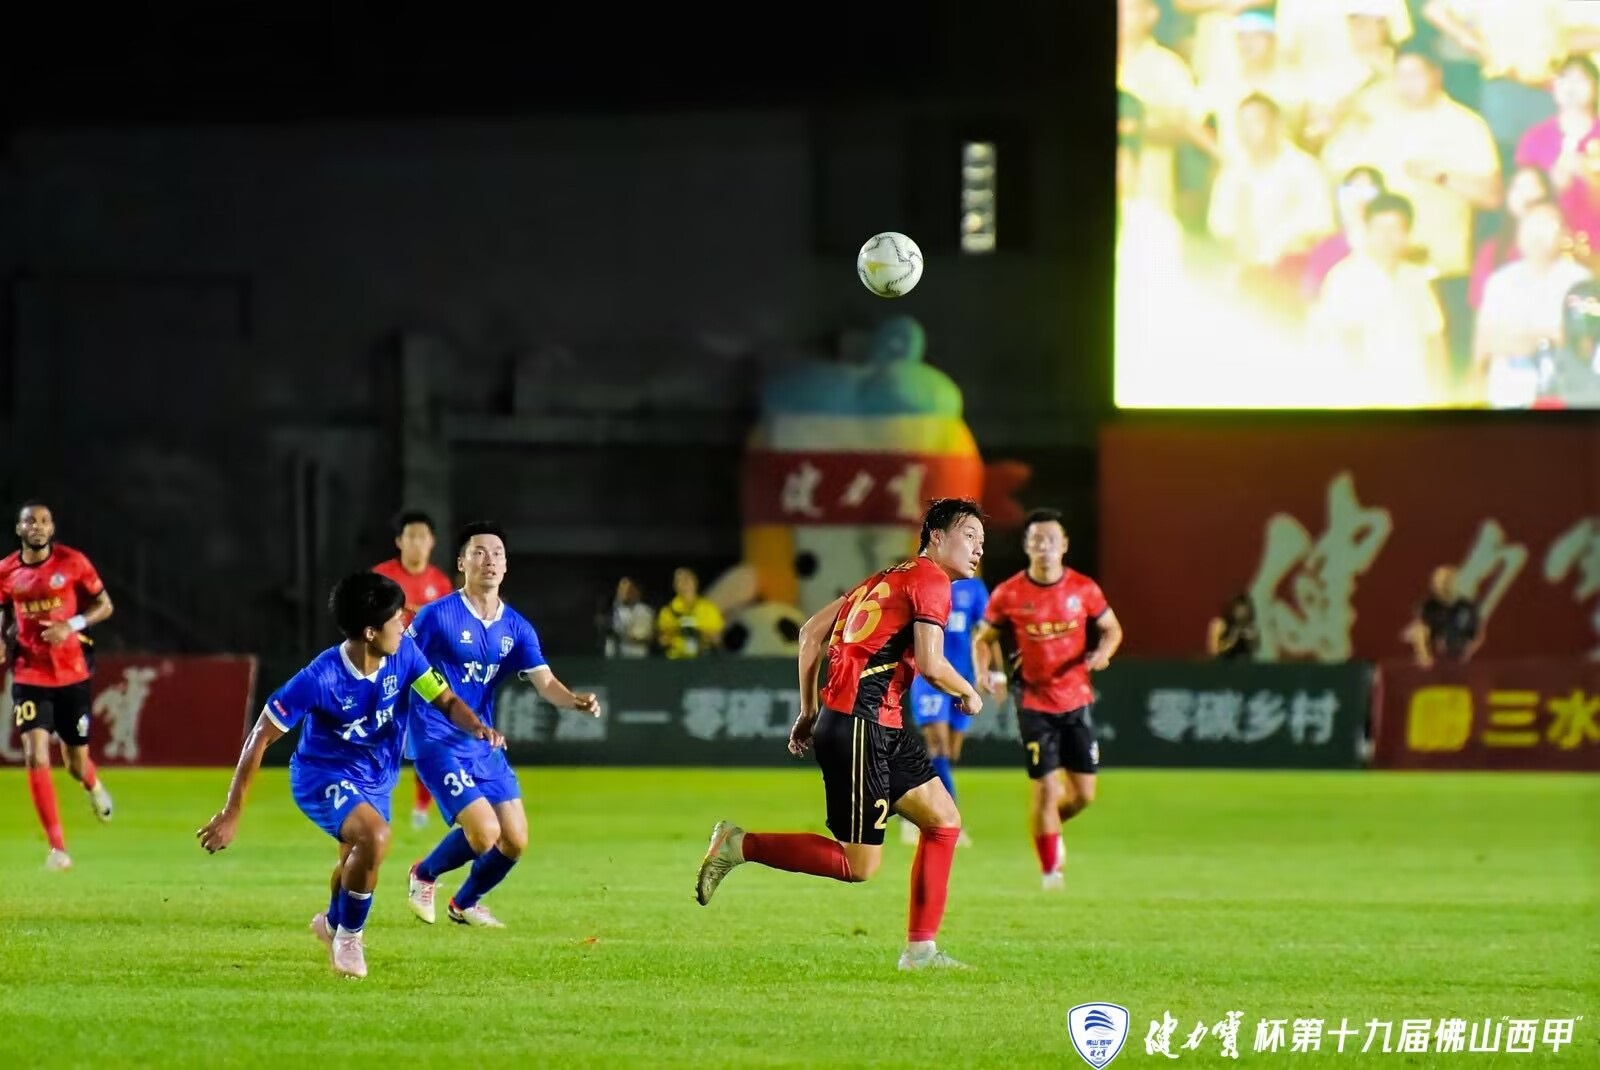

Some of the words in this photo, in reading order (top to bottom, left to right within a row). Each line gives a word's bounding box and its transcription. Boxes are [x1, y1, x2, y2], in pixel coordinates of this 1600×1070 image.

[14, 699, 37, 727] 20
[1026, 741, 1041, 766] 7
[443, 768, 475, 797] 36
